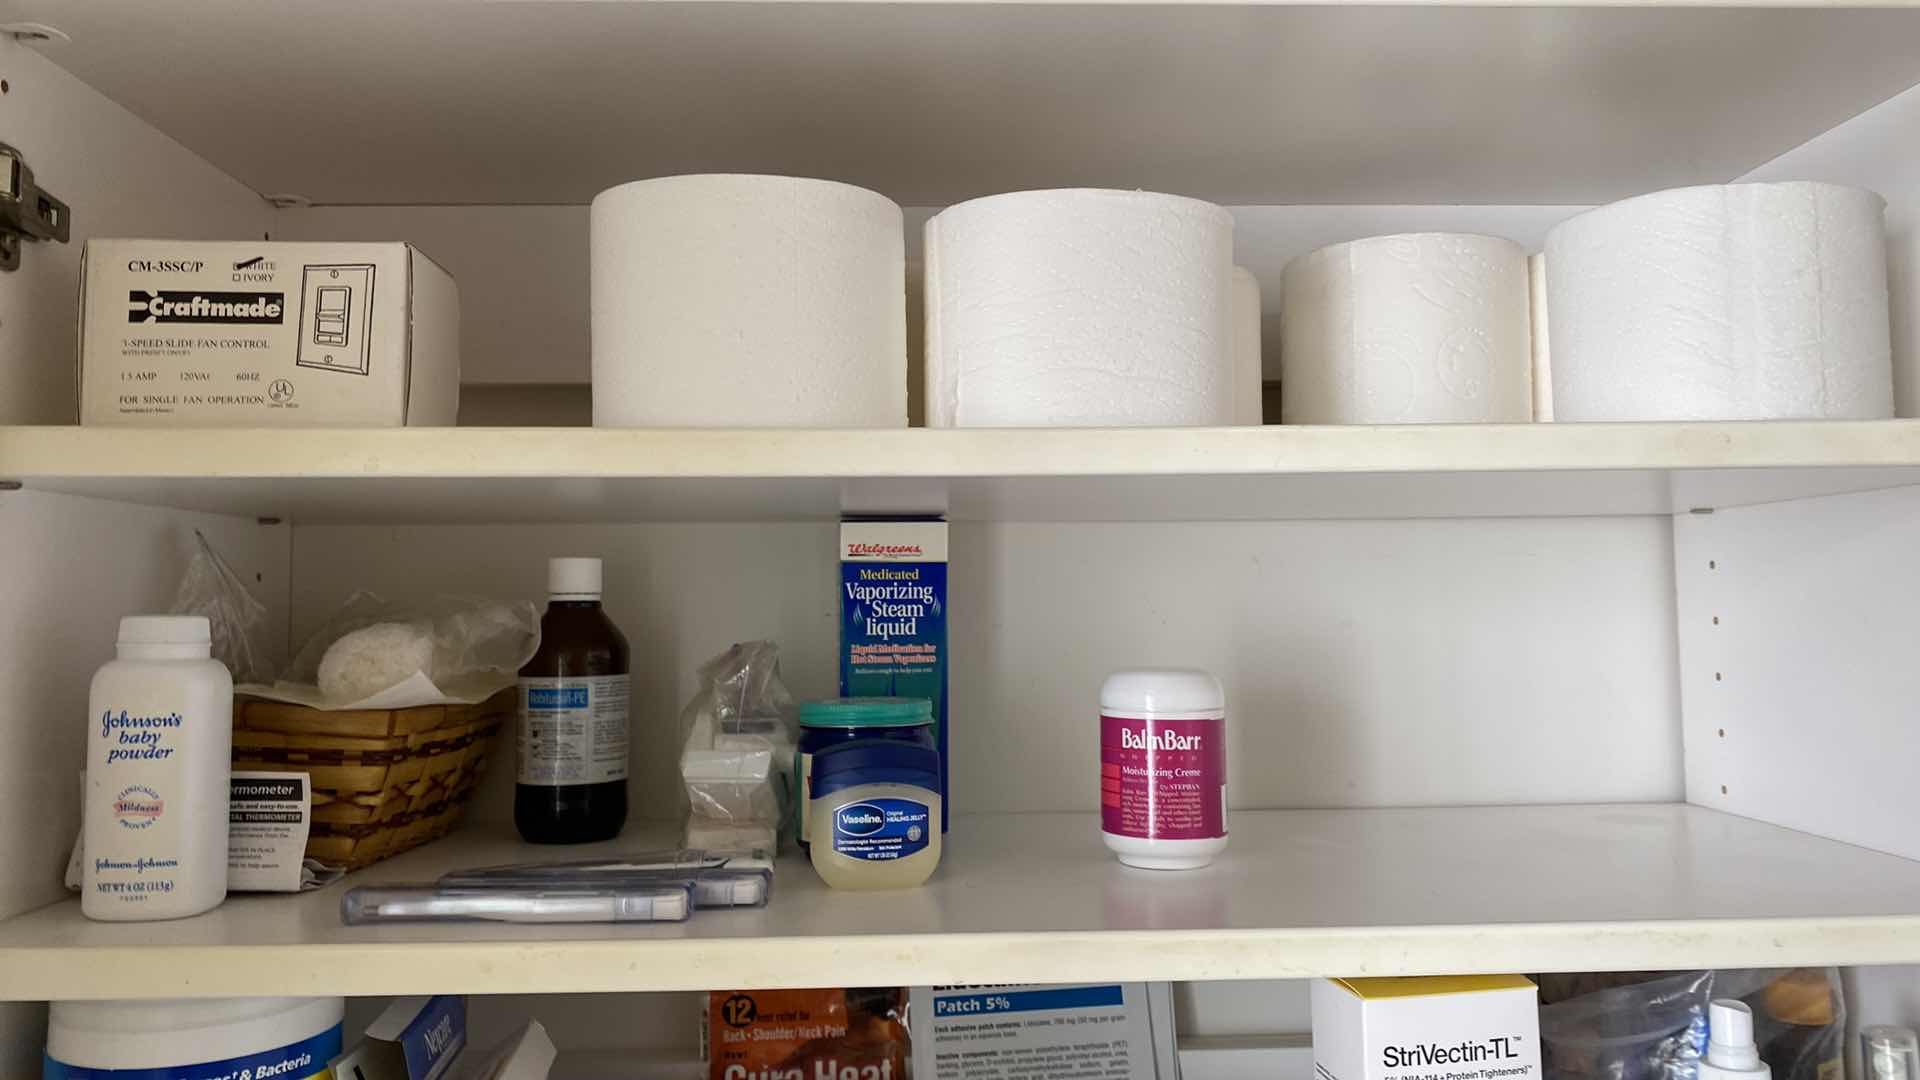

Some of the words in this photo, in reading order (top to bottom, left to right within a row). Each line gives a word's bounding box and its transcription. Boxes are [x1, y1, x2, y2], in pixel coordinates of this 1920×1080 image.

[128, 260, 204, 273] CM-3SSC/P
[243, 273, 274, 282] IVORY
[149, 296, 281, 317] Craftmade
[165, 338, 193, 349] SLIDE
[197, 339, 218, 349] FAN
[219, 339, 270, 349] CONTROL
[135, 372, 158, 381] AMP
[236, 372, 261, 382] 60HZ
[119, 395, 139, 405] FOR
[143, 395, 177, 405] SINGLE
[183, 395, 203, 405] FAN
[207, 395, 265, 405] OPERATION
[847, 543, 922, 555] Walgreens
[859, 569, 920, 581] Medicated
[845, 582, 934, 605] Vaporizing
[871, 600, 924, 618] Steam
[865, 618, 917, 640] liquid
[102, 710, 181, 738] Johnson's
[119, 730, 162, 745] baby
[107, 745, 174, 764] powder
[1175, 767, 1201, 777] Creme
[119, 802, 160, 812] Mildness
[245, 813, 302, 821] THERMOMETER
[96, 883, 111, 892] NET
[111, 883, 125, 892] WT
[133, 883, 145, 892] OZ
[936, 998, 980, 1013] Patch
[986, 996, 1011, 1010] 5%
[726, 999, 752, 1025] 12
[722, 1029, 746, 1042] Back
[824, 1024, 846, 1038] Pain
[978, 1022, 994, 1032] patch
[255, 1053, 312, 1080] Bacteria
[1446, 1070, 1479, 1080] Protein
